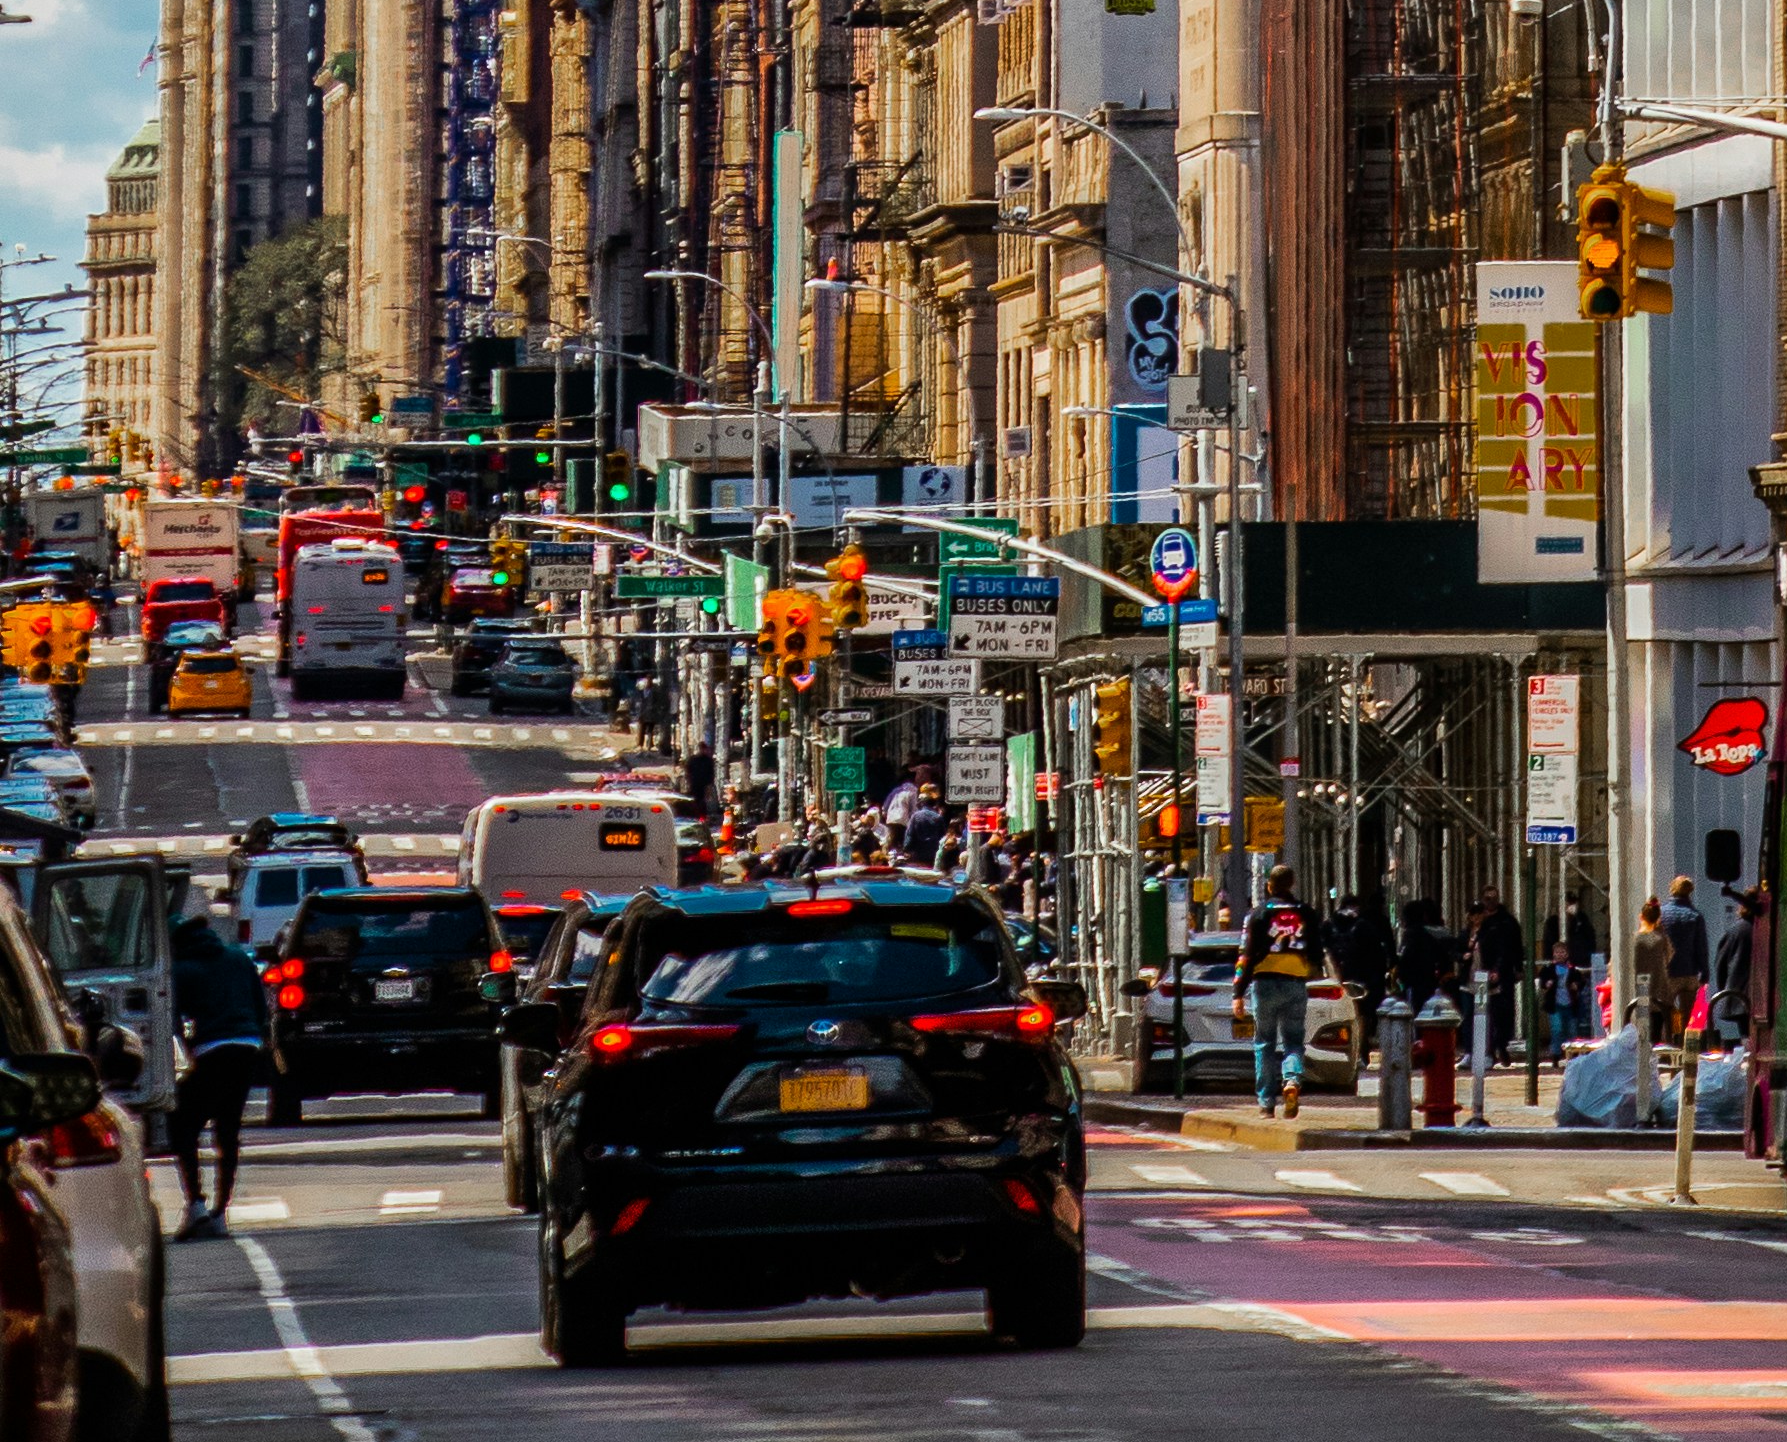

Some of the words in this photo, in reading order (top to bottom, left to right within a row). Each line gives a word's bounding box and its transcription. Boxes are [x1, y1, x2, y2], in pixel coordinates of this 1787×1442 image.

[1481, 340, 1548, 385] VIS
[1496, 392, 1579, 438] ION
[1505, 447, 1593, 491] ARY
[645, 580, 687, 593] Walker
[976, 580, 1005, 593] BUS
[1011, 580, 1051, 594] LANE
[956, 598, 1006, 611] BUSES
[1012, 600, 1051, 612] ONLY
[898, 649, 937, 660] BUSES
[1532, 678, 1543, 694] 3
[1690, 746, 1717, 765] La
[1532, 755, 1542, 772] 2
[960, 768, 990, 779] MUST
[604, 805, 642, 820] 2631
